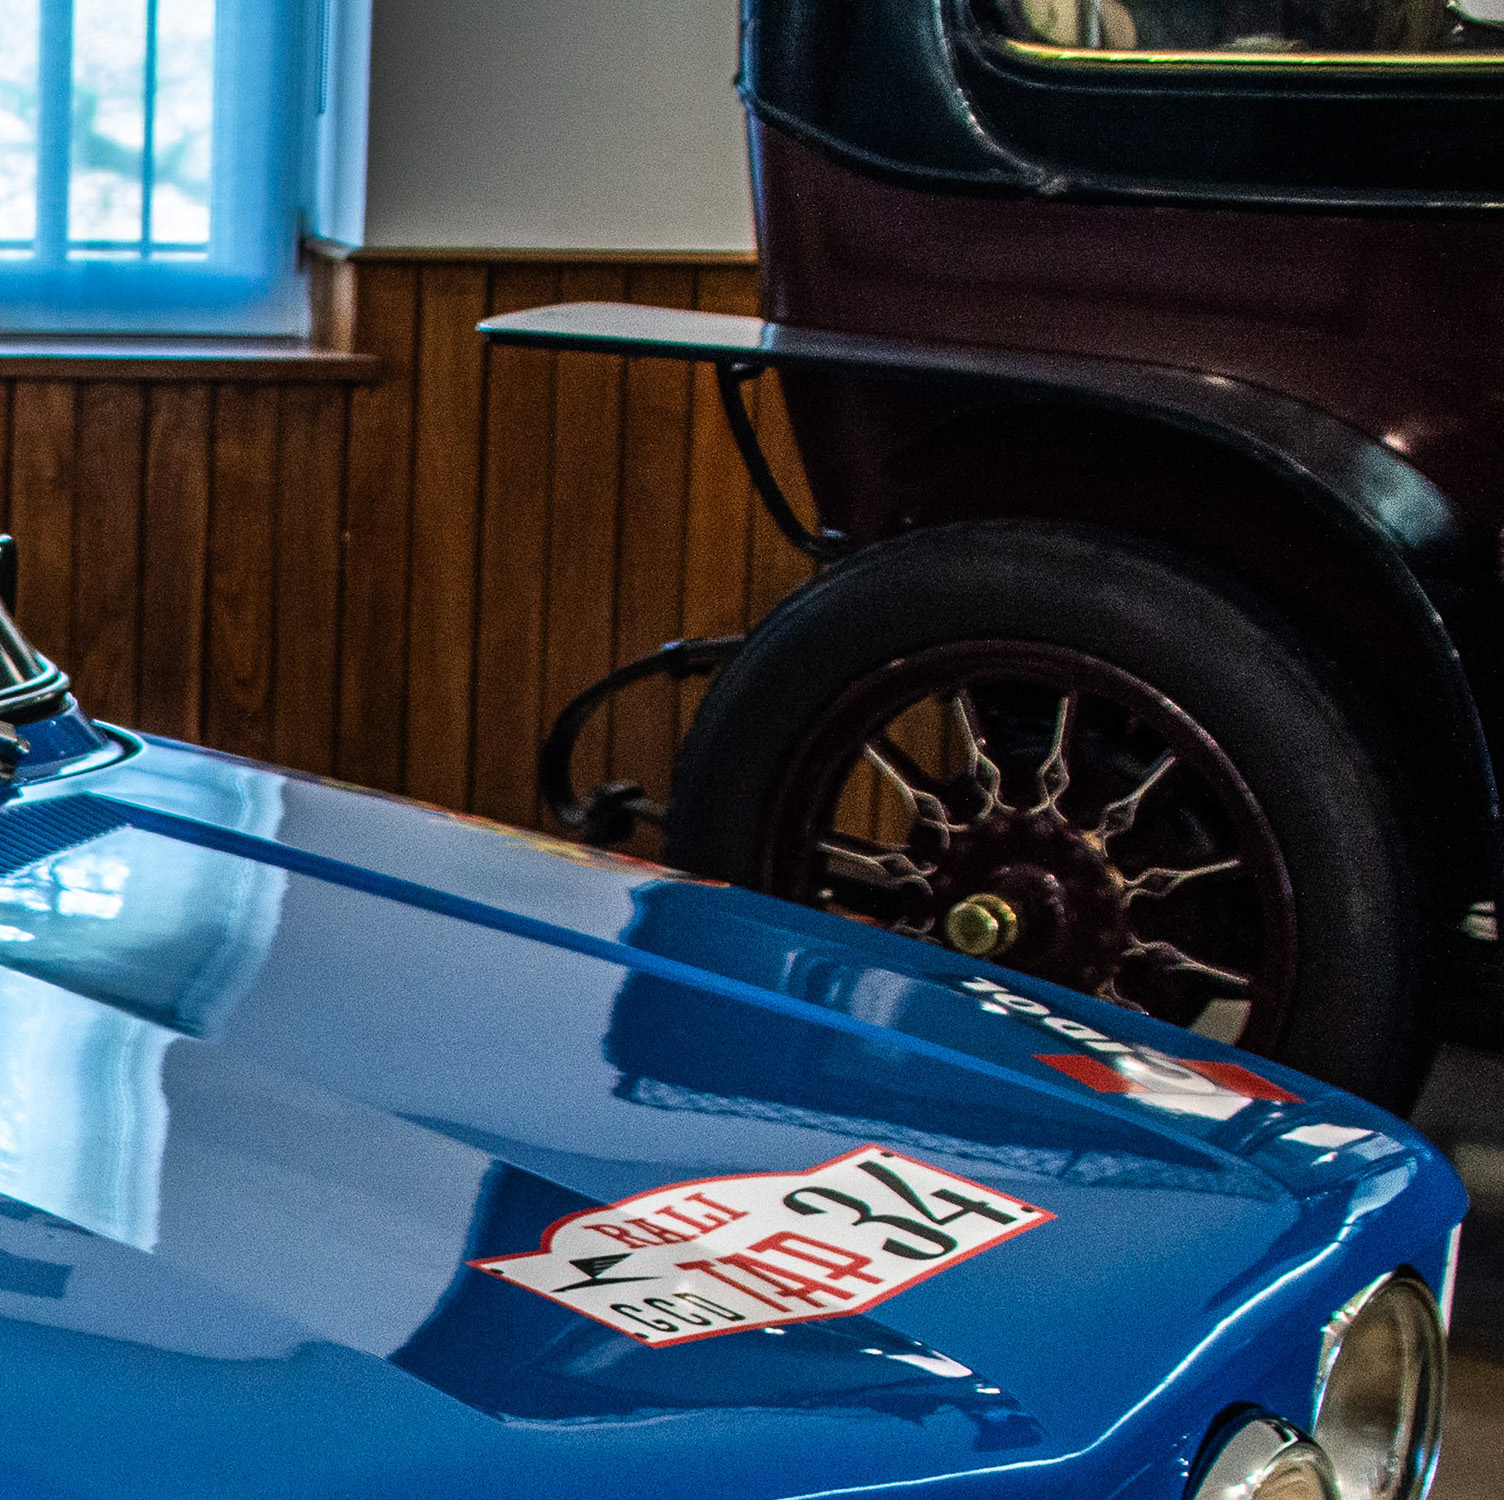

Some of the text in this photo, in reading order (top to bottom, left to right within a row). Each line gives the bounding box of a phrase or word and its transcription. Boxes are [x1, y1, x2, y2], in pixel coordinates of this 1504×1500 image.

[583, 1191, 750, 1250] RALI
[782, 1159, 1017, 1262] 34
[675, 1230, 886, 1313] TAP
